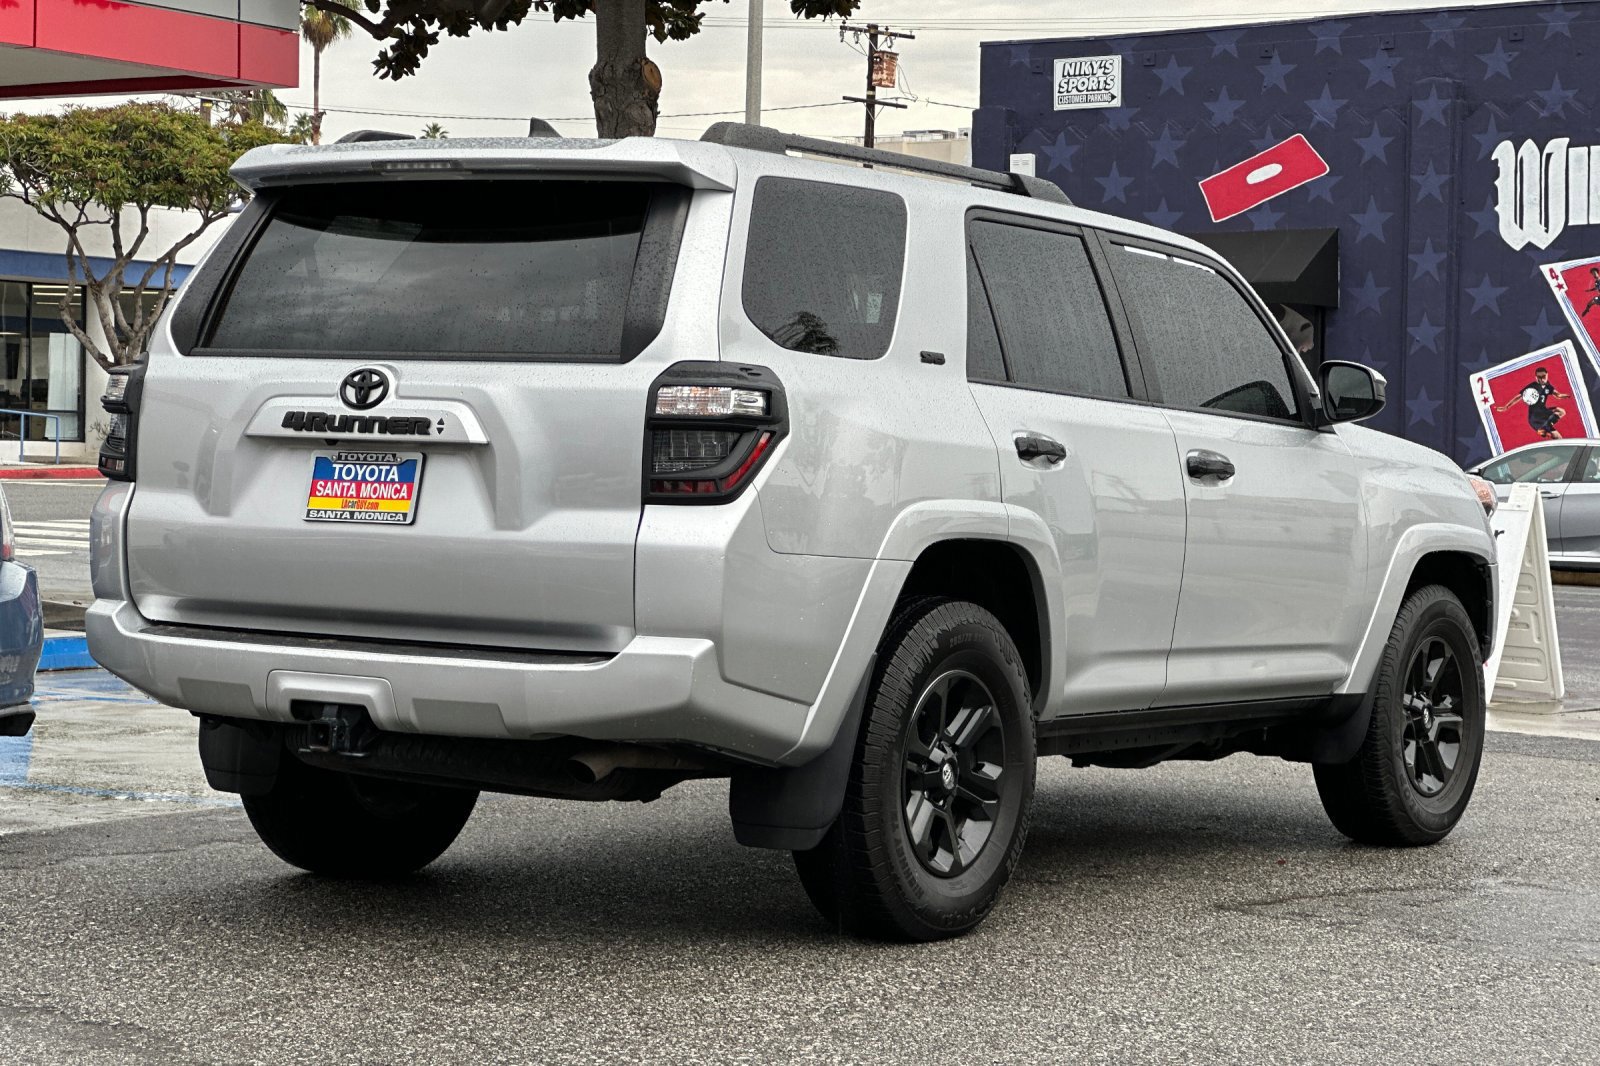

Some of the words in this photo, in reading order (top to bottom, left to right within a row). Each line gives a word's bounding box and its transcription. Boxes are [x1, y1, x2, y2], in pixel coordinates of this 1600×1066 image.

[1062, 59, 1115, 78] NIKY'S
[1058, 75, 1116, 94] SPORTS
[1058, 94, 1087, 105] CUSTOMER
[1087, 92, 1112, 103] PARKING
[1477, 377, 1486, 395] 2
[340, 453, 394, 462] TOYOTA
[332, 464, 399, 482] TOYOTA
[315, 481, 357, 498] SANTA
[360, 483, 408, 499] MONICA
[309, 510, 351, 519] SANTA
[353, 512, 404, 521] MONICA
